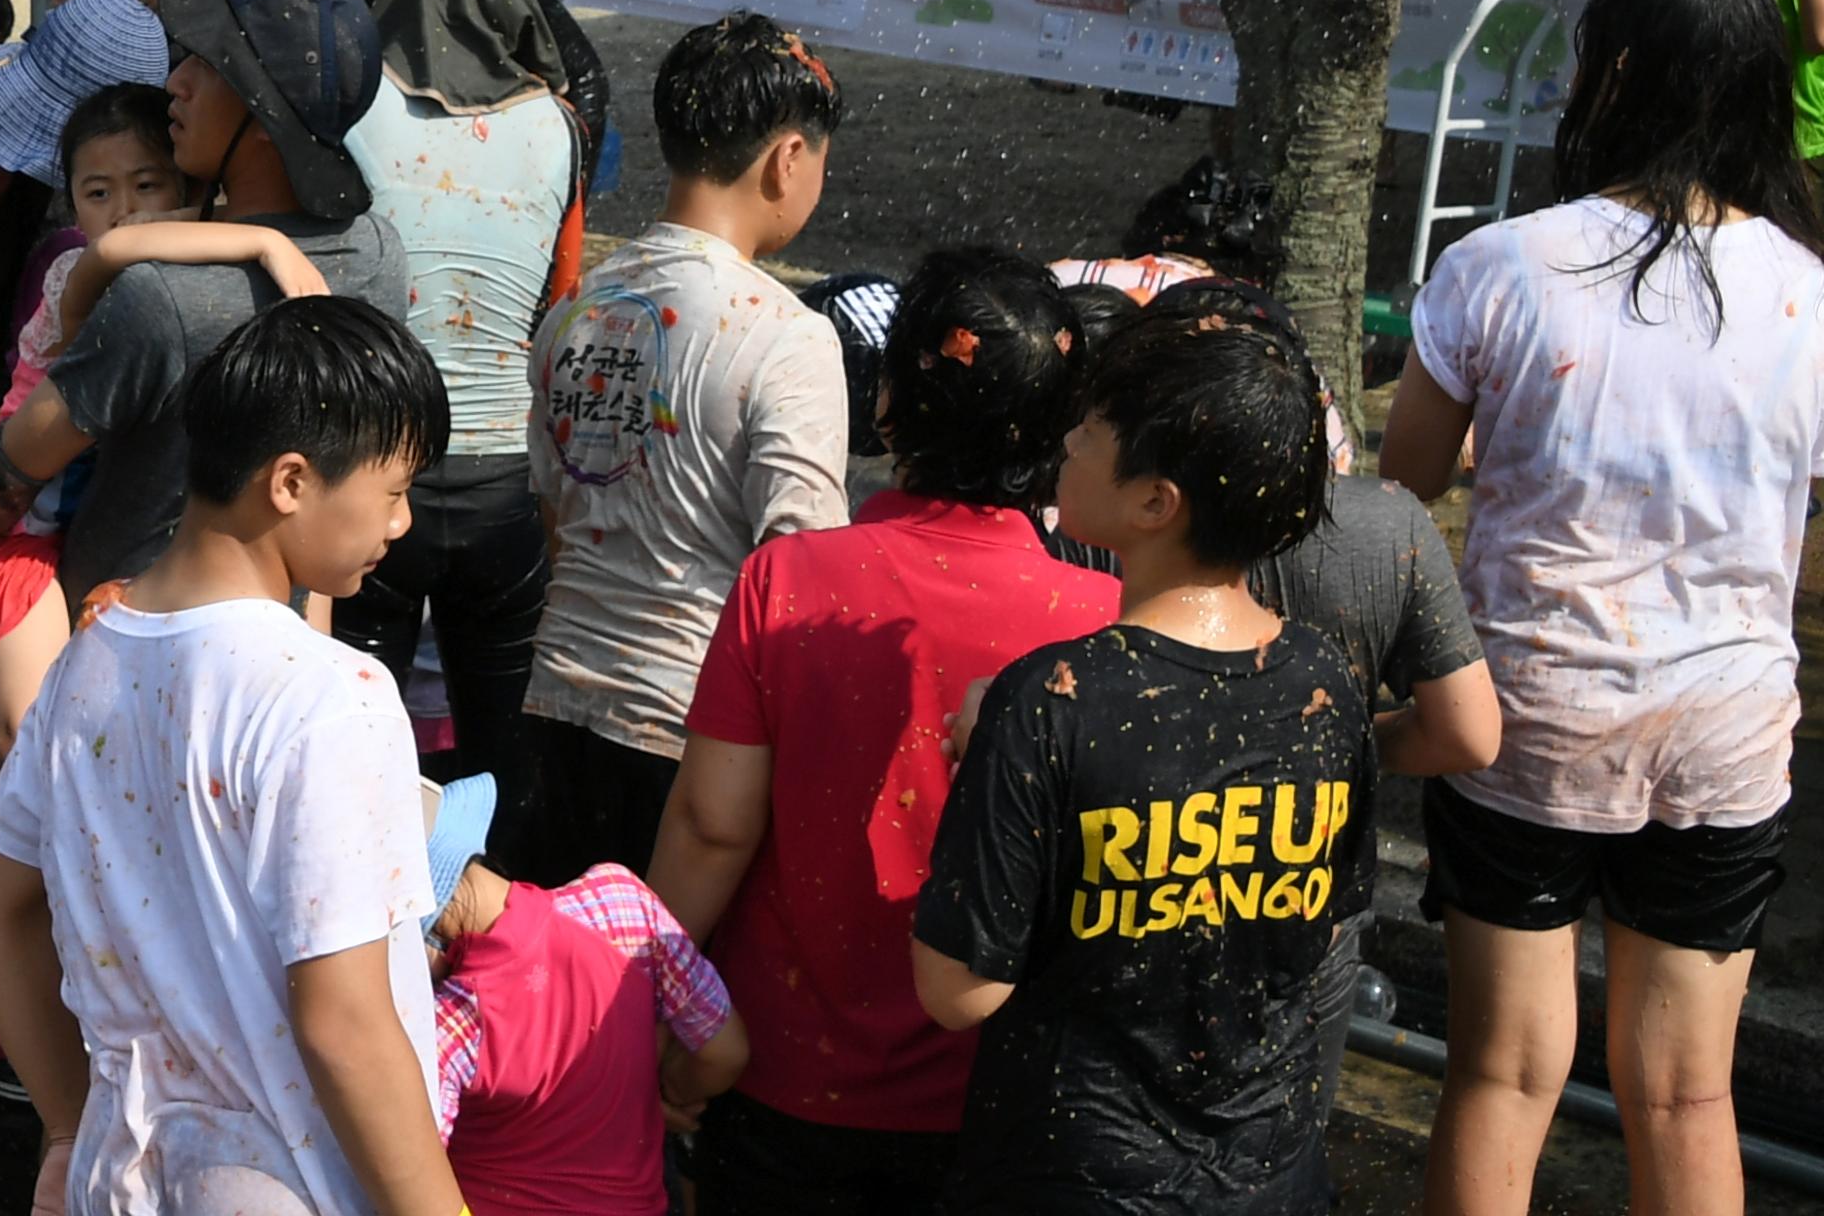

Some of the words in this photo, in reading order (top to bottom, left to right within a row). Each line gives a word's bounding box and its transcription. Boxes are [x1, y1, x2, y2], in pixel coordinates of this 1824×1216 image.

[555, 344, 645, 382] 성균관
[1079, 786, 1263, 885] RISE
[1271, 781, 1350, 864] UP
